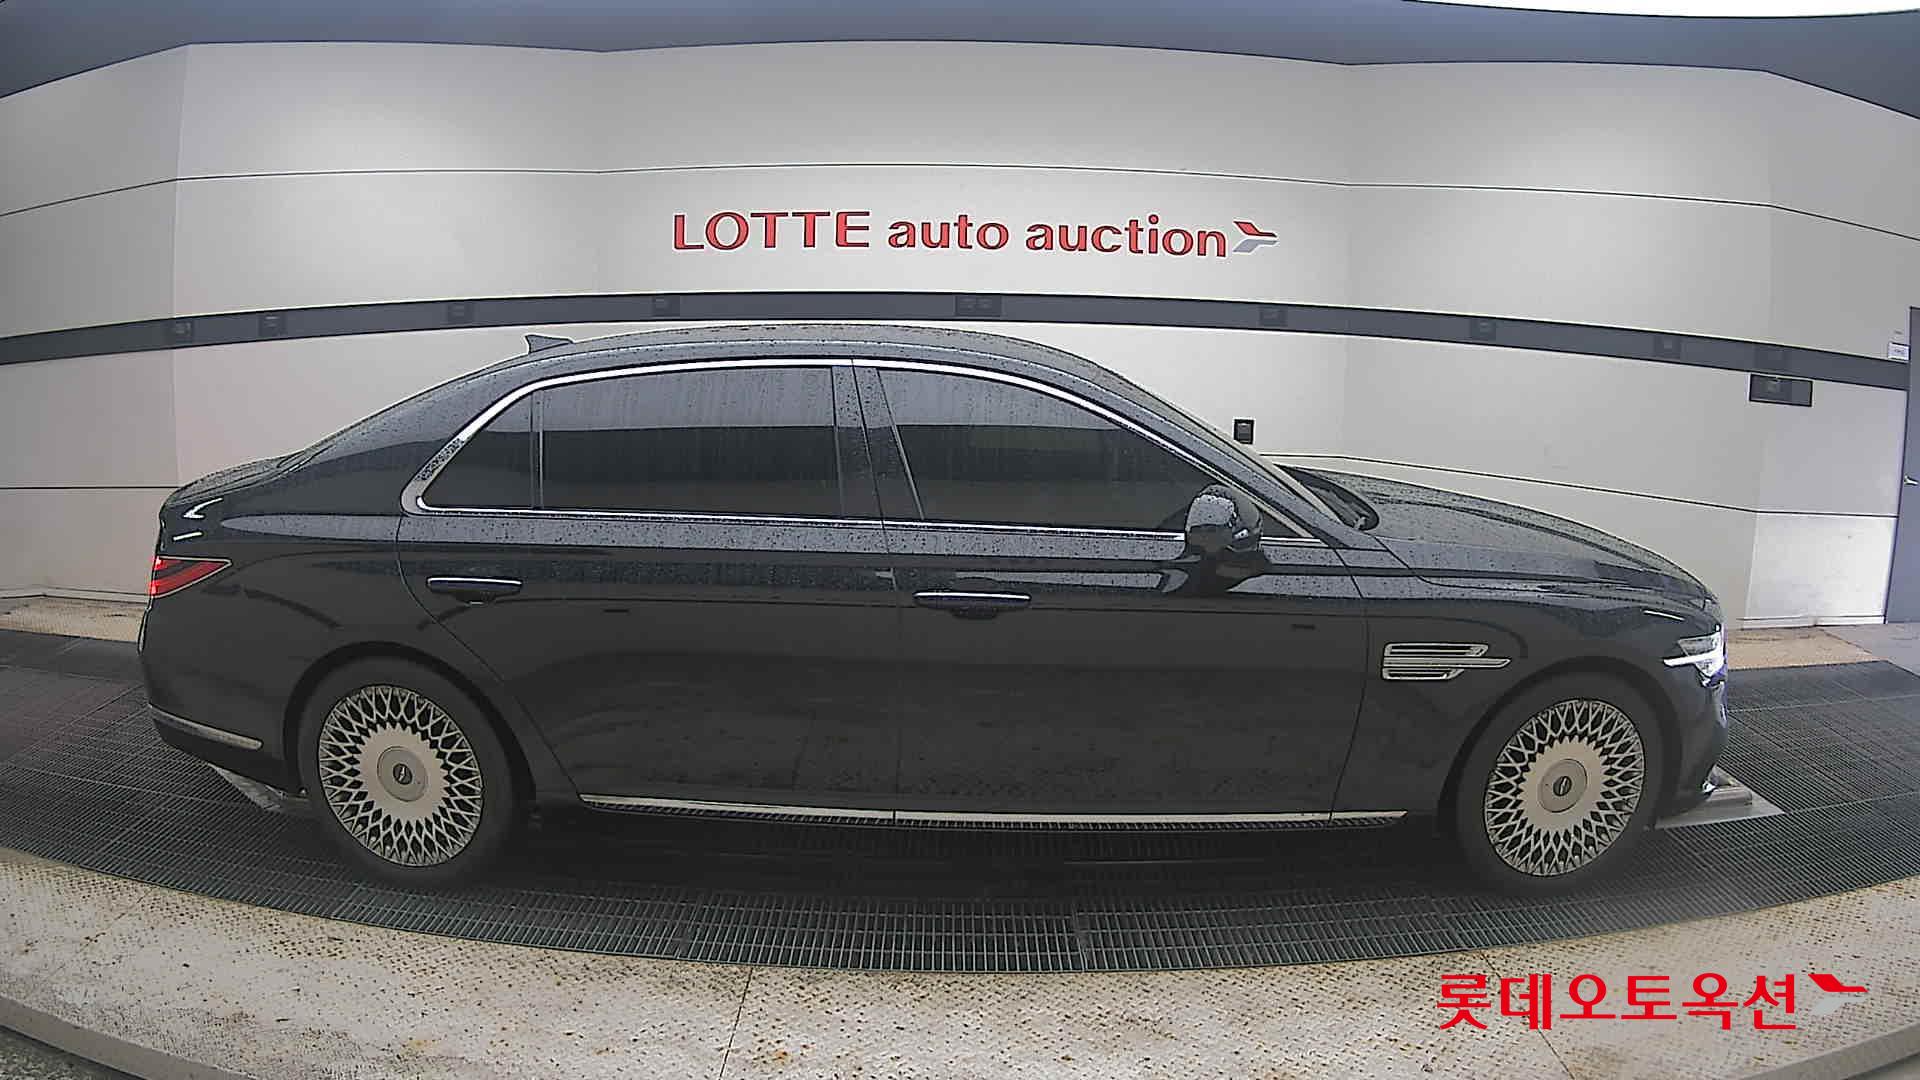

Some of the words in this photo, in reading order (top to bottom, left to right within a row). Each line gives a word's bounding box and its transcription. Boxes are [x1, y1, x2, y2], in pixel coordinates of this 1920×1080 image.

[673, 211, 870, 250] LOTTE
[888, 214, 1009, 250] auto
[1026, 214, 1227, 257] auction
